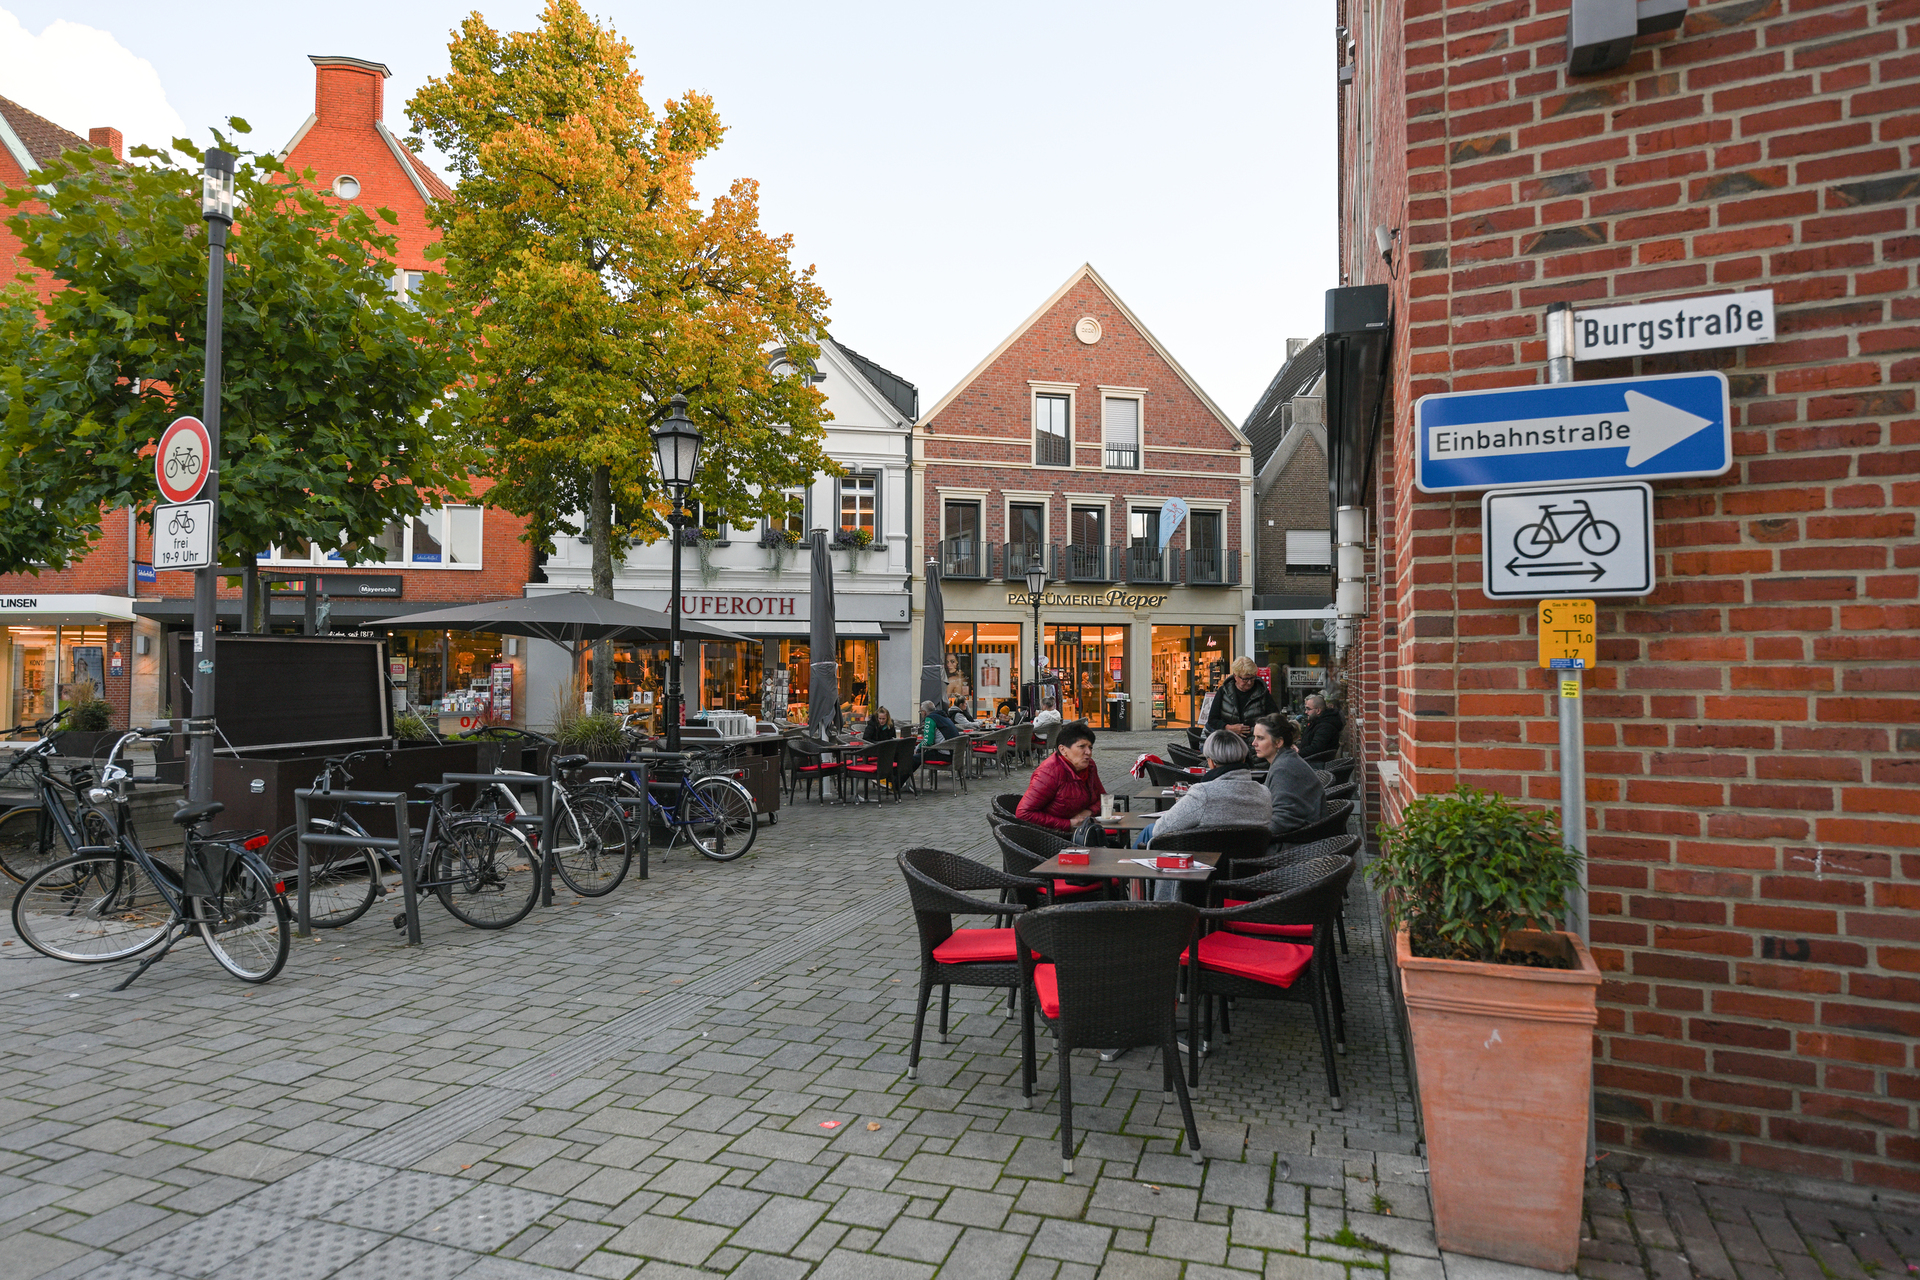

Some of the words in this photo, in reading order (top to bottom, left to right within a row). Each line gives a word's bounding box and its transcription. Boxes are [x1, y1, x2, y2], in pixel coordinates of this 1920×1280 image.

[1584, 303, 1763, 350] Burgstraße
[1437, 420, 1631, 453] Einbahnstraße
[174, 537, 189, 549] frei
[162, 551, 180, 564] 19-9
[182, 550, 199, 562] Uhr
[0, 598, 37, 608] LINSEN
[1008, 592, 1103, 606] PARFÜMERIE
[1106, 590, 1168, 610] Pieper
[900, 610, 905, 618] 3
[1542, 608, 1553, 624] S
[1572, 613, 1593, 624] 150
